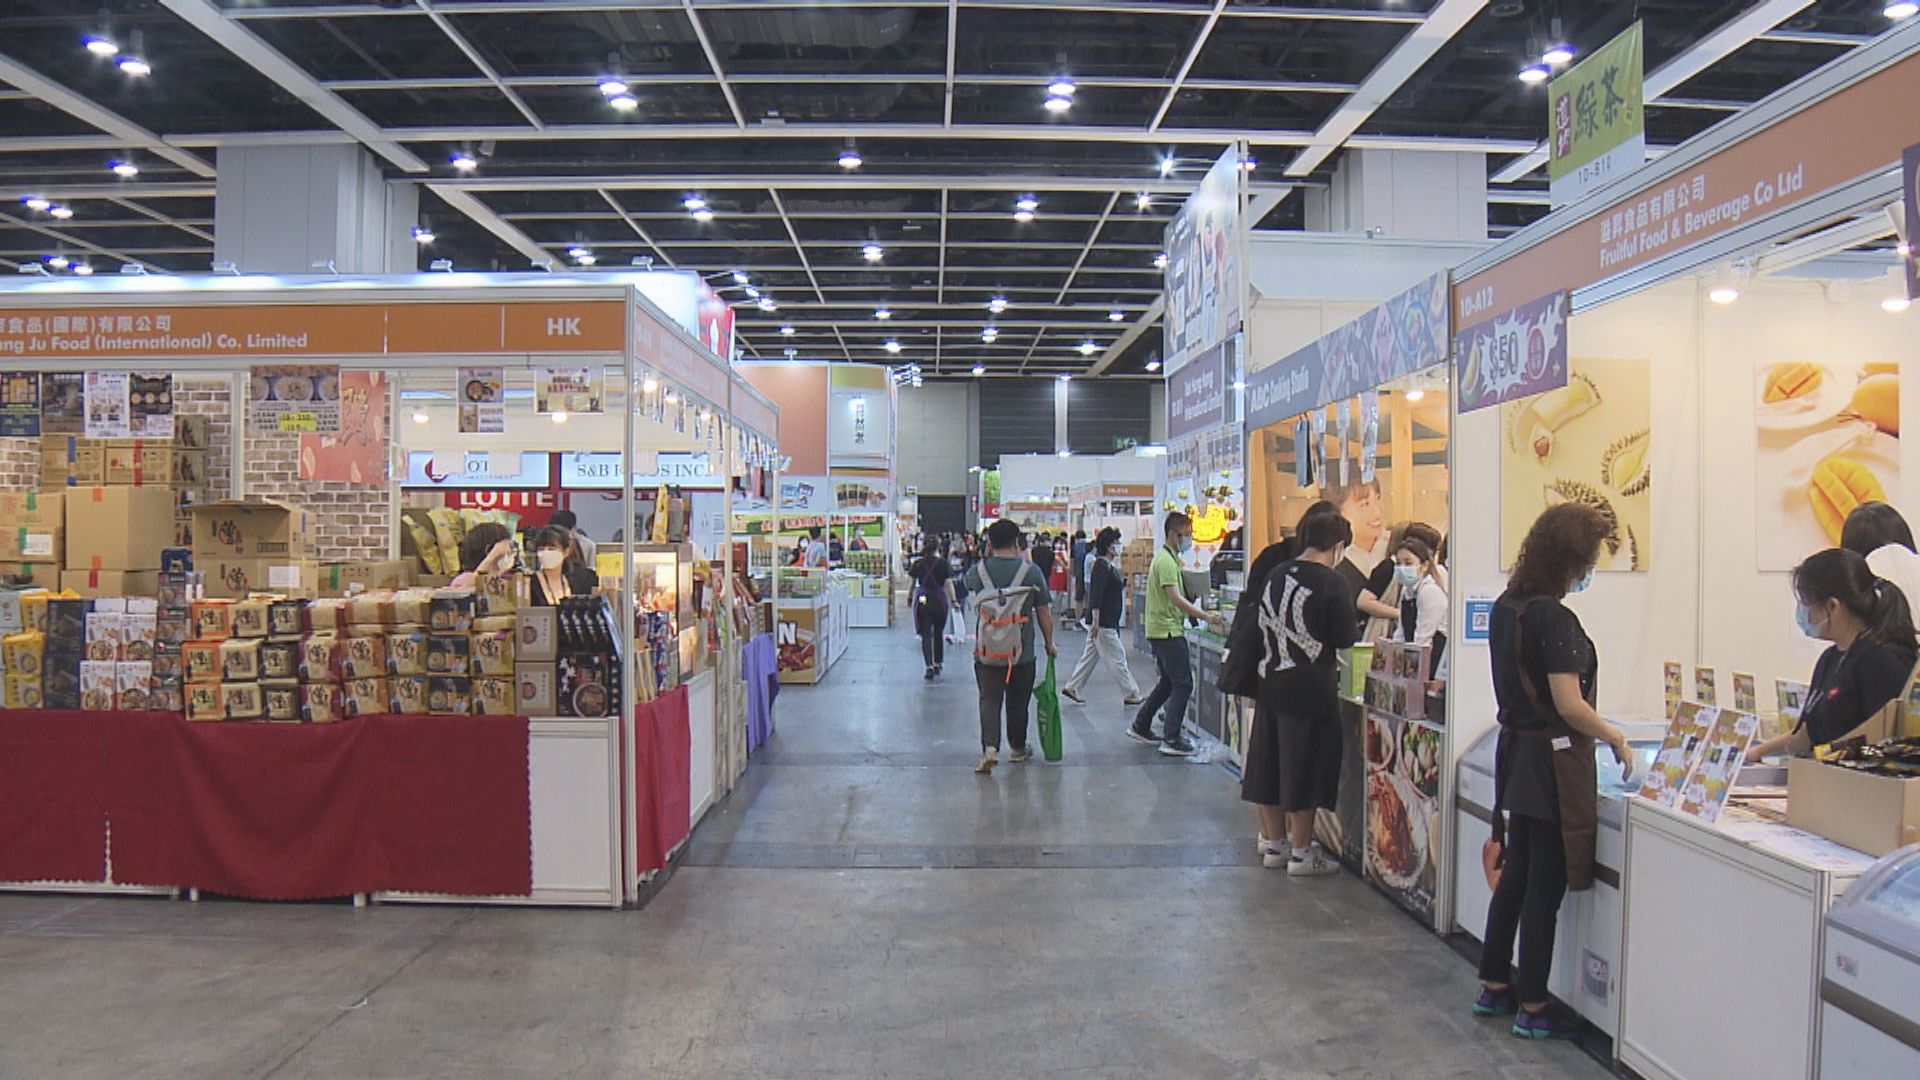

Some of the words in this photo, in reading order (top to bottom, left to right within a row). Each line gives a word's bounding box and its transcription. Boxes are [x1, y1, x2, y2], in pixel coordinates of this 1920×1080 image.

[1600, 235, 1637, 268] Fruitful
[1639, 220, 1668, 250] Food
[1671, 218, 1681, 238] &
[1684, 194, 1750, 235] Beverage
[1754, 178, 1773, 206] Co
[1777, 162, 1803, 198] Ltd
[1460, 286, 1493, 319] 1D-A12
[28, 335, 47, 351] Ju
[51, 335, 91, 351] Food
[95, 332, 212, 351] (International)
[217, 333, 242, 349] Co.
[247, 332, 308, 348] Limited
[546, 317, 581, 336] HK
[1488, 331, 1519, 385] $50
[1250, 382, 1270, 414] ABC
[577, 463, 609, 477] S&B
